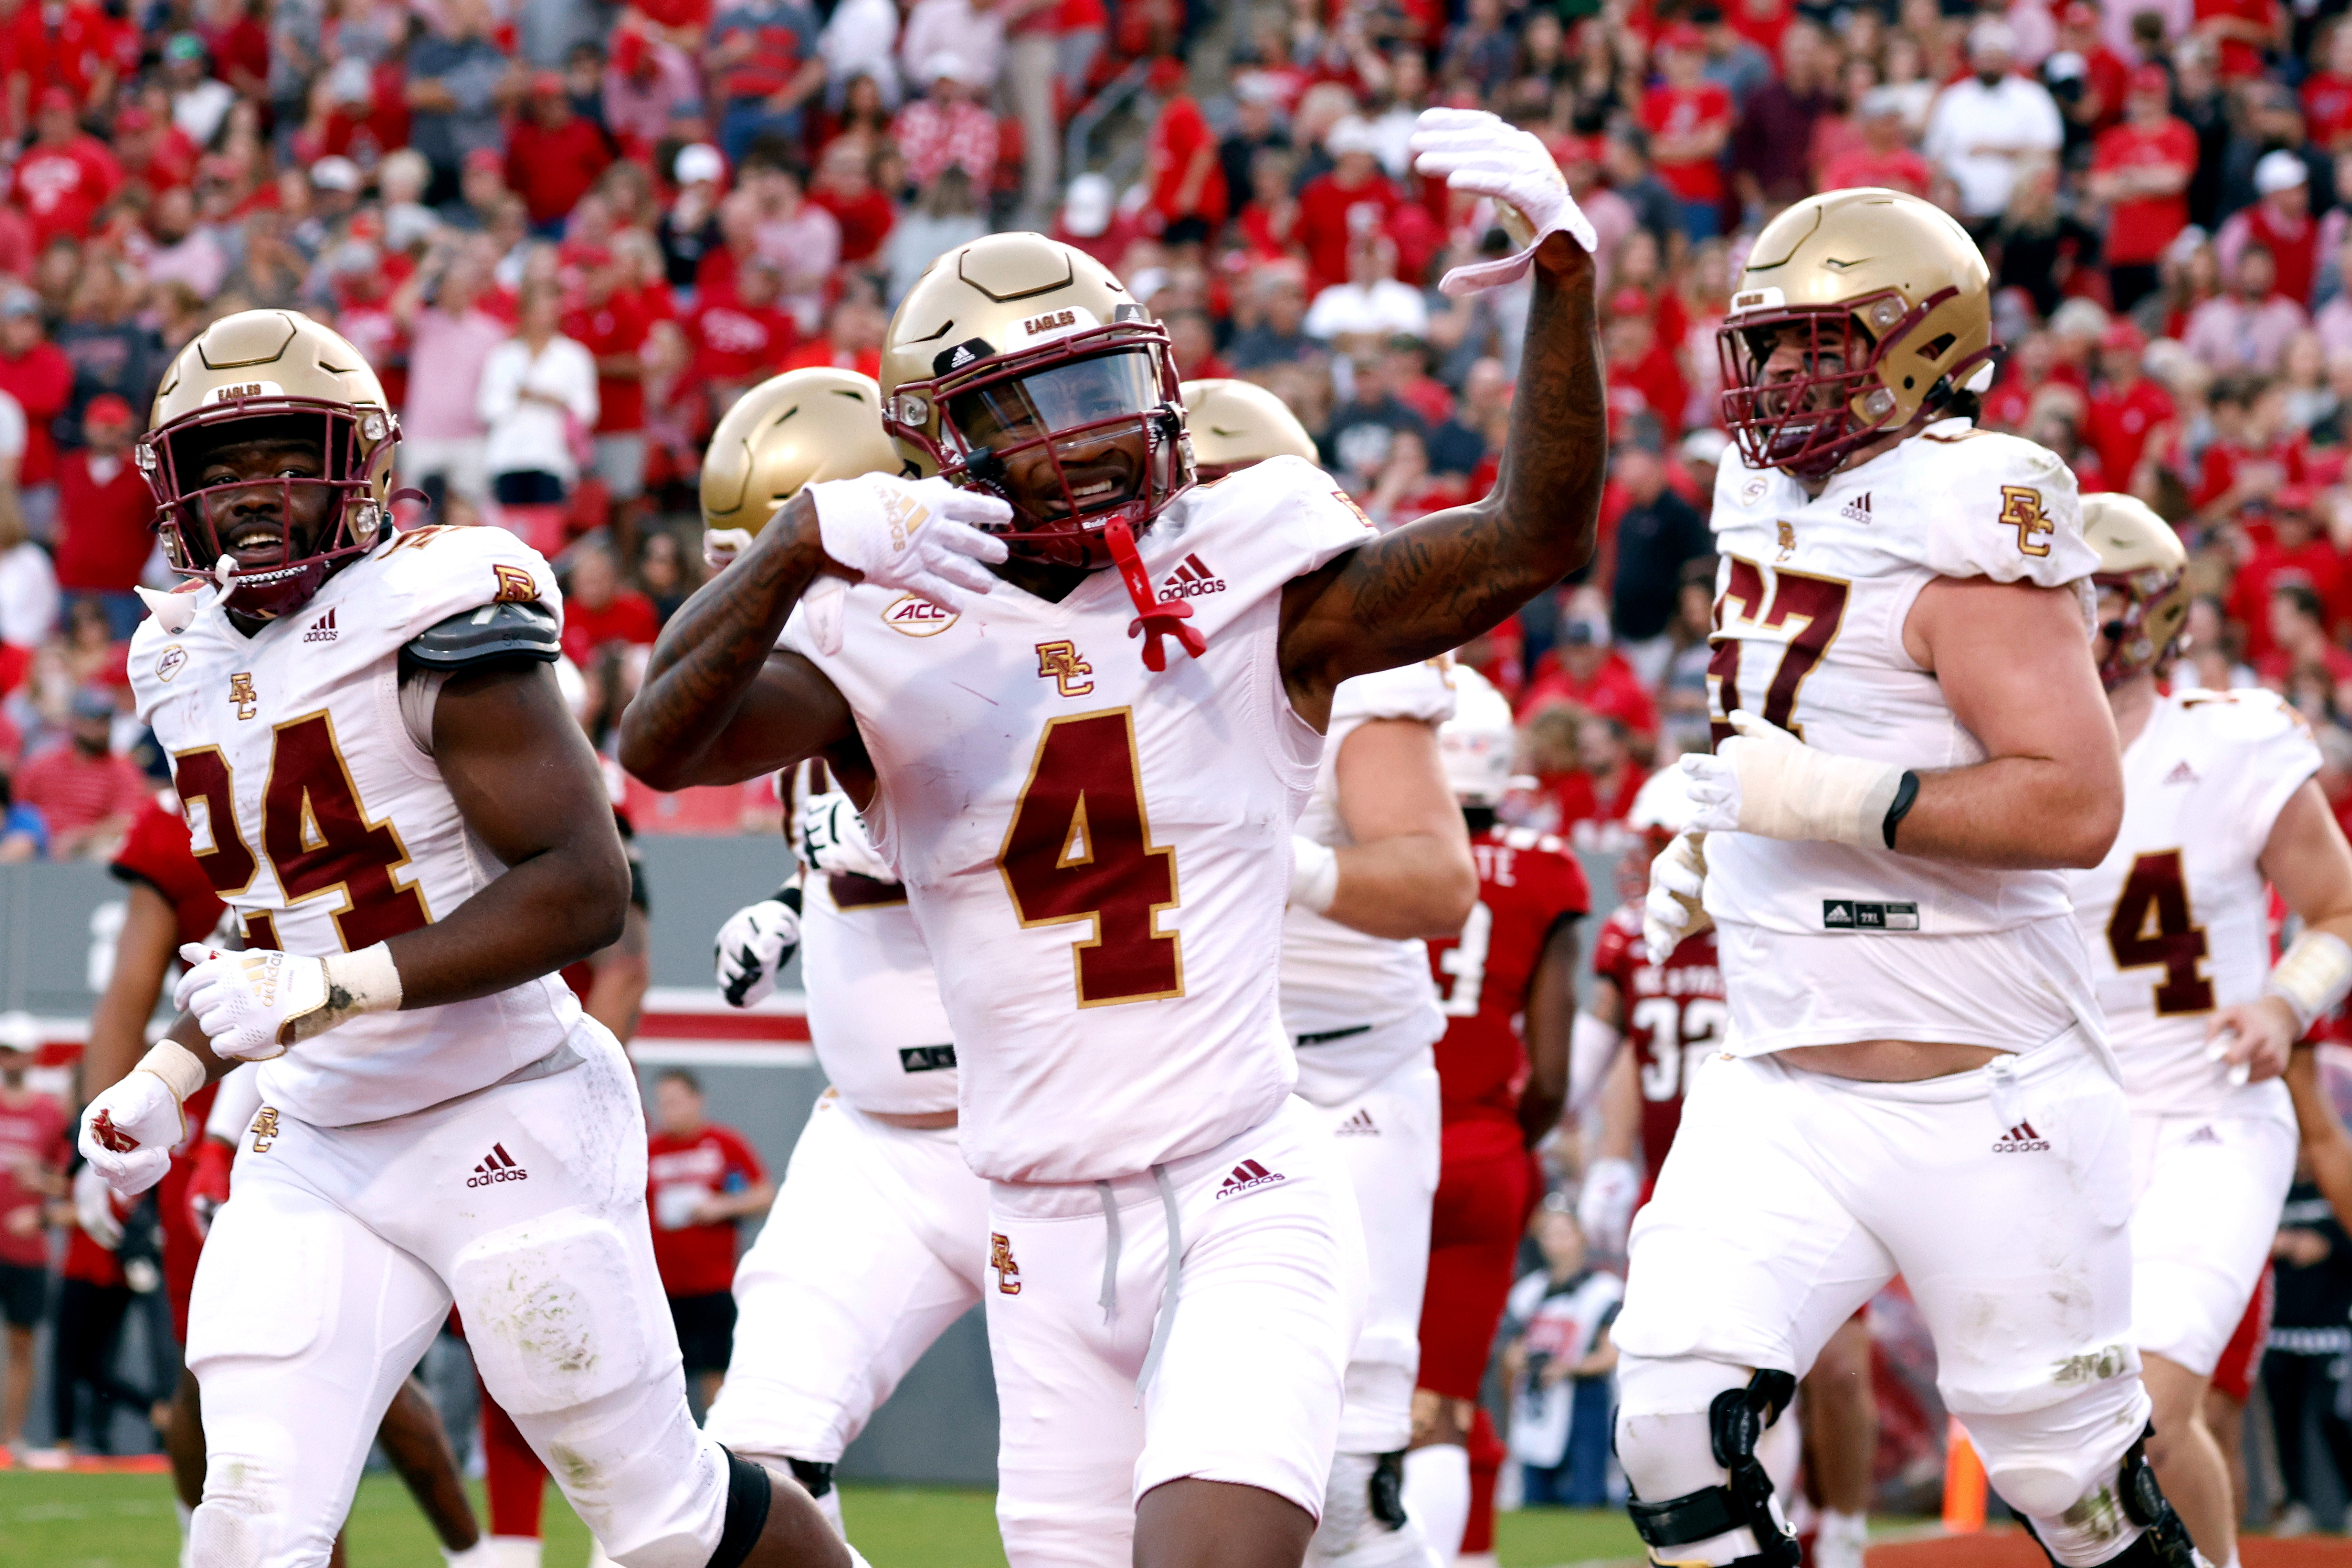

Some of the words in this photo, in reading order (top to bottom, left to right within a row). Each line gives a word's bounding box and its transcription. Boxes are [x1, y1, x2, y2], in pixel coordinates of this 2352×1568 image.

[1023, 310, 1075, 336] EAGLES
[218, 384, 261, 401] EAGLES
[1999, 485, 2054, 557] BC
[1158, 579, 1226, 602] adidas
[893, 602, 946, 619] ACC
[303, 628, 338, 643] adidas
[1035, 640, 1095, 697] BC
[173, 708, 434, 953] 24
[997, 705, 1185, 1010] 4
[2106, 847, 2216, 1018] 4
[262, 952, 284, 1007] adidas
[1992, 1140, 2051, 1152] adidas
[467, 1167, 527, 1188] adidas
[1216, 1173, 1286, 1200] adidas
